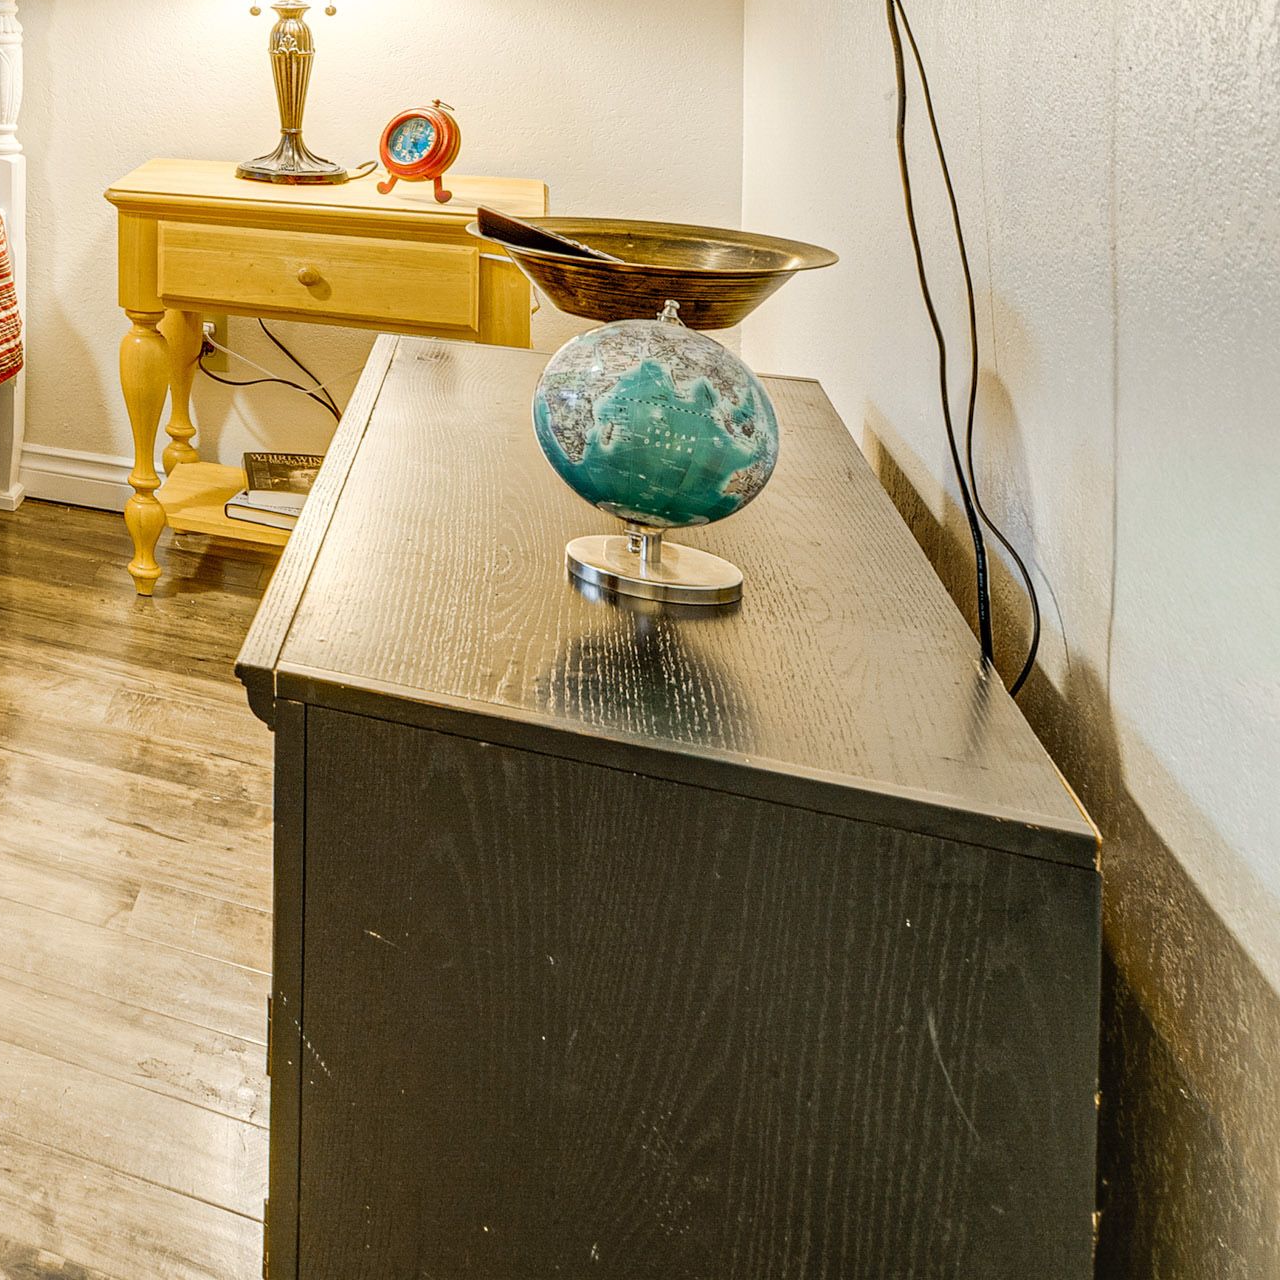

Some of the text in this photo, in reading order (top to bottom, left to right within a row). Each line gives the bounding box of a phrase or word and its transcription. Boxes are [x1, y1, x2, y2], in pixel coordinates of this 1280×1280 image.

[647, 427, 696, 442] INDIAN
[644, 438, 693, 454] OCEAN
[250, 453, 322, 464] WHIRLWIN
